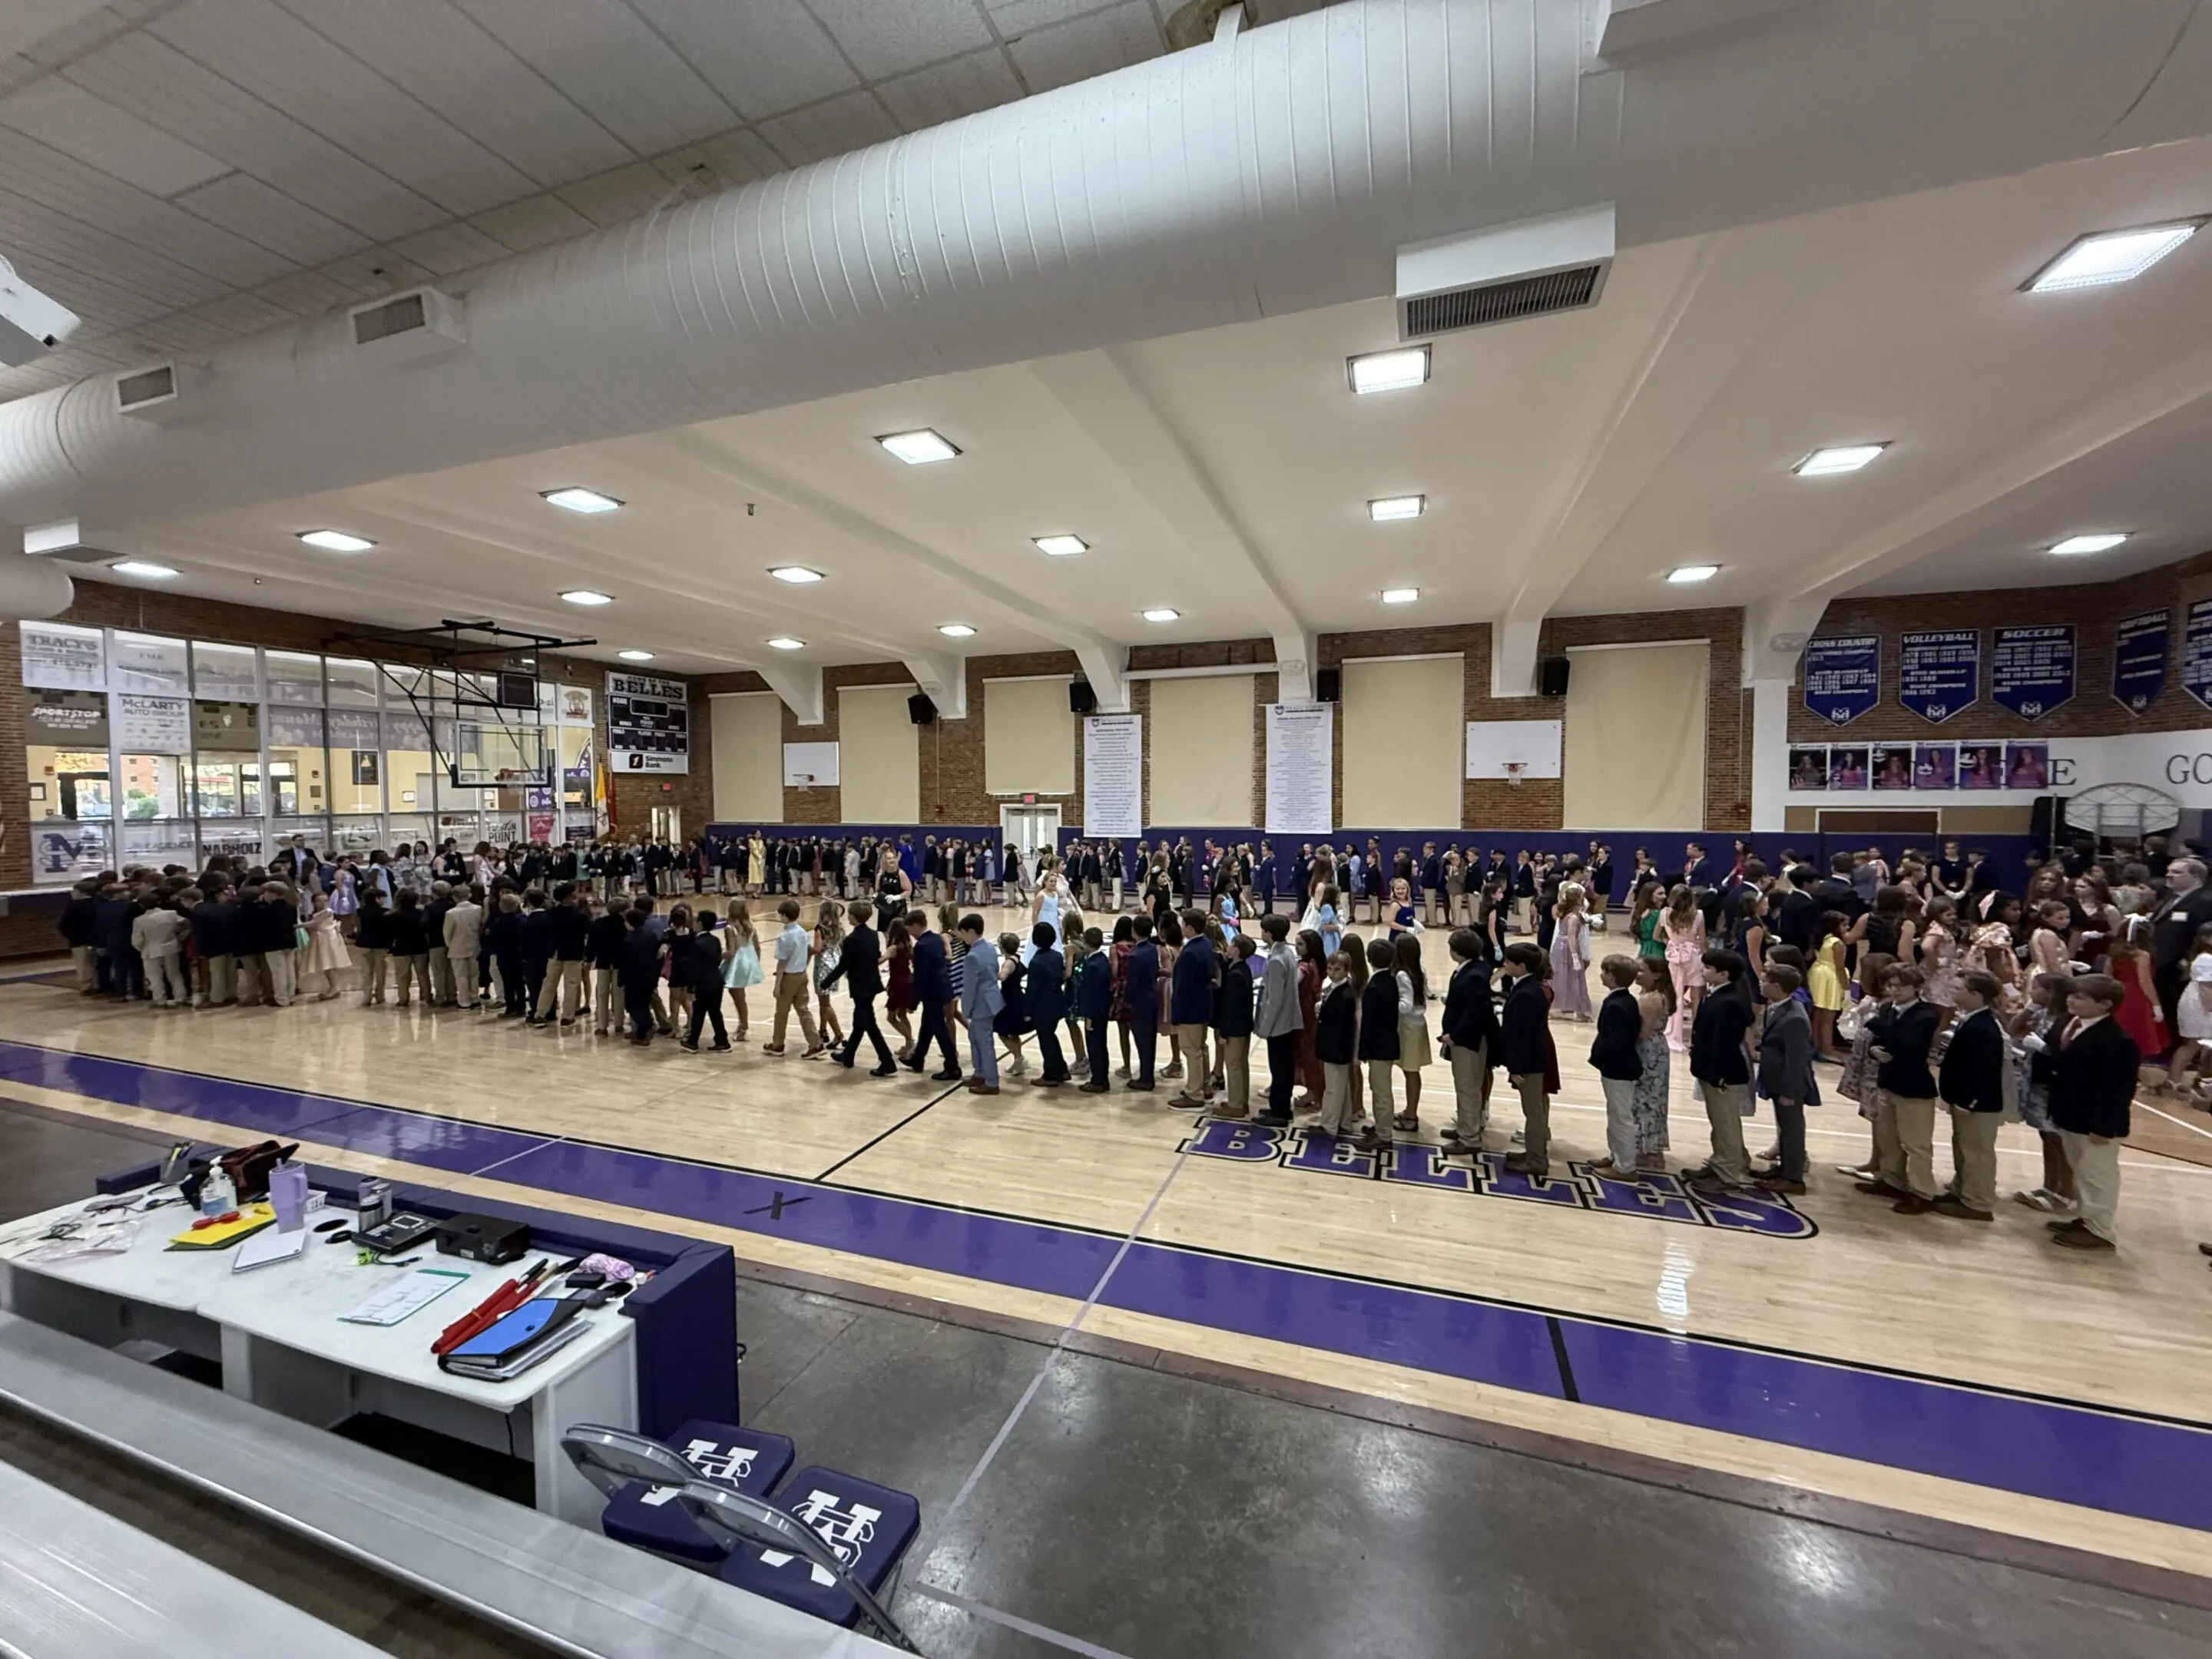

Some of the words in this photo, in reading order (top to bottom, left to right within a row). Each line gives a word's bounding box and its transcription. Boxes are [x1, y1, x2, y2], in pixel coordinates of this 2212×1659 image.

[1903, 633, 1975, 643] VOLLEYBALL
[2001, 628, 2065, 638] SOCCER
[1837, 637, 1877, 647] COUNTRY
[612, 678, 683, 699] BELLES
[122, 699, 185, 710] McLARTY
[488, 831, 516, 843] POINT
[203, 842, 262, 856] NABHOLZ
[1175, 1115, 1820, 1238] BELLES
